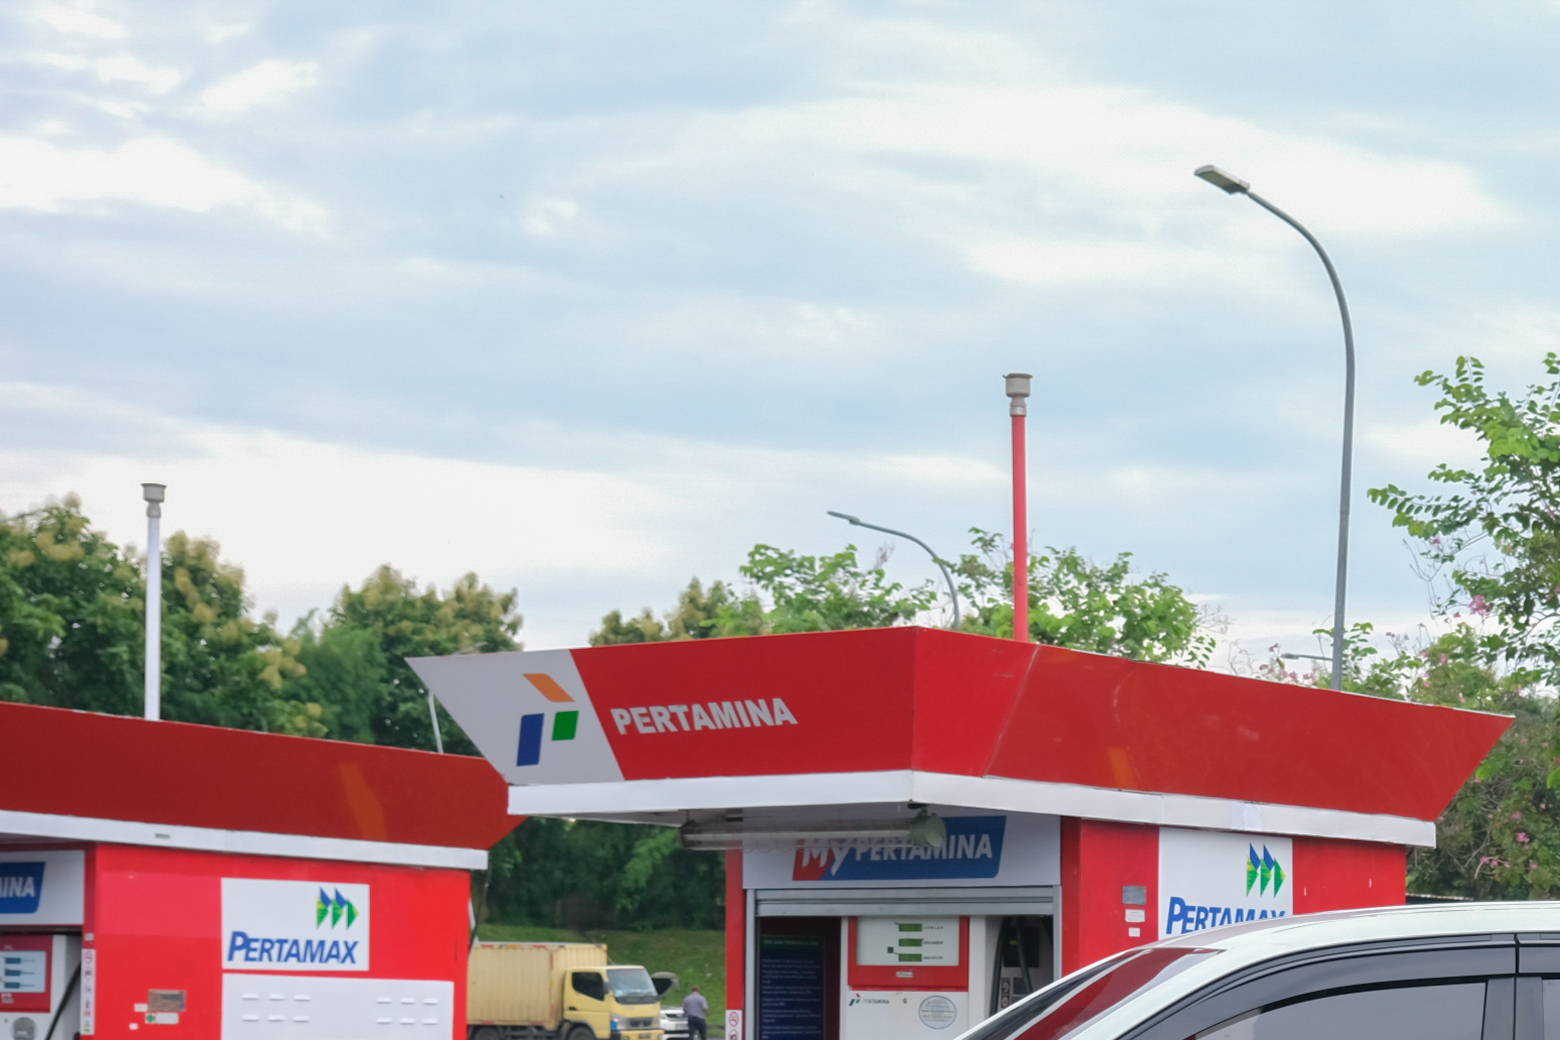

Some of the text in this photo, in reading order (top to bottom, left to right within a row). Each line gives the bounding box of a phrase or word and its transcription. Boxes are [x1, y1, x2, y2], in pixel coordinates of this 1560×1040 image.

[611, 697, 798, 735] PERTAMINA
[1166, 896, 1287, 935] PERTAM
[227, 930, 359, 964] PERTAMAX
